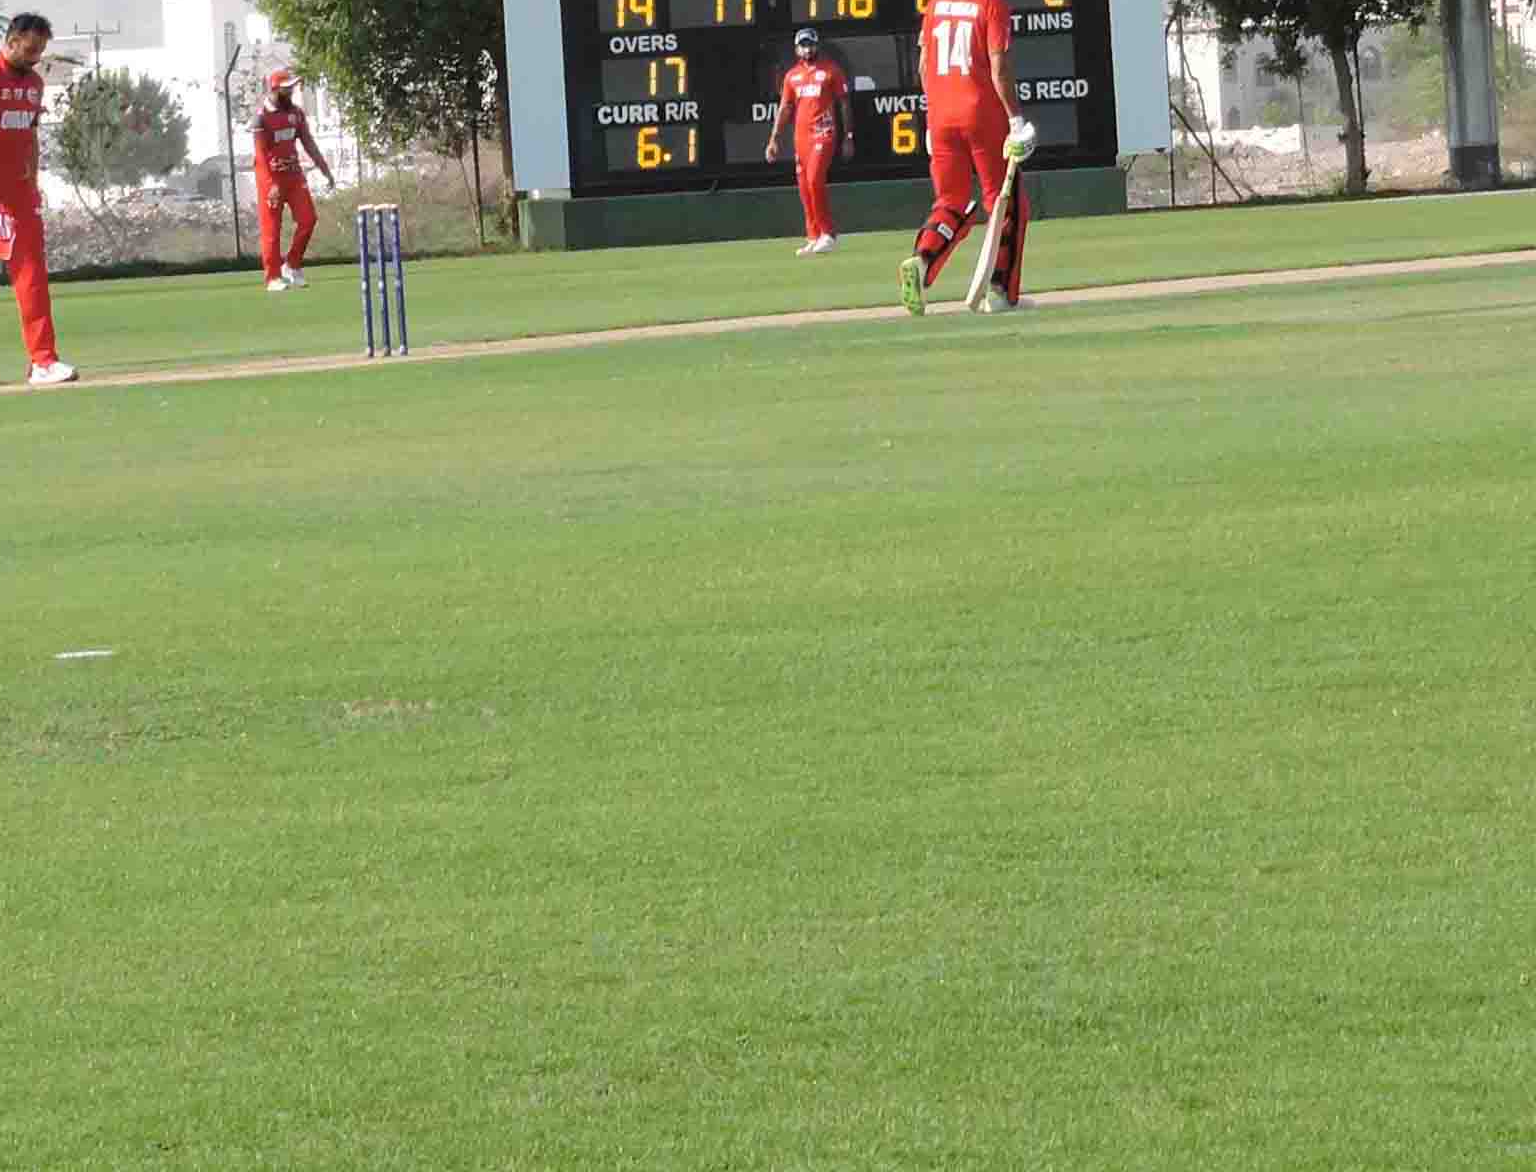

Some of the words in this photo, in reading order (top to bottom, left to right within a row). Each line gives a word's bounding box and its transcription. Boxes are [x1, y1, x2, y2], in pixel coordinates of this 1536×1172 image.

[1027, 12, 1073, 32] INNS
[609, 33, 678, 54] OVERS
[933, 19, 973, 76] 14
[648, 56, 687, 96] 17
[1036, 79, 1089, 100] REQD
[597, 103, 660, 125] CURR
[665, 100, 700, 122] R/R
[874, 93, 929, 115] WKTS
[892, 112, 917, 154] 6
[637, 125, 696, 170] 6.1
